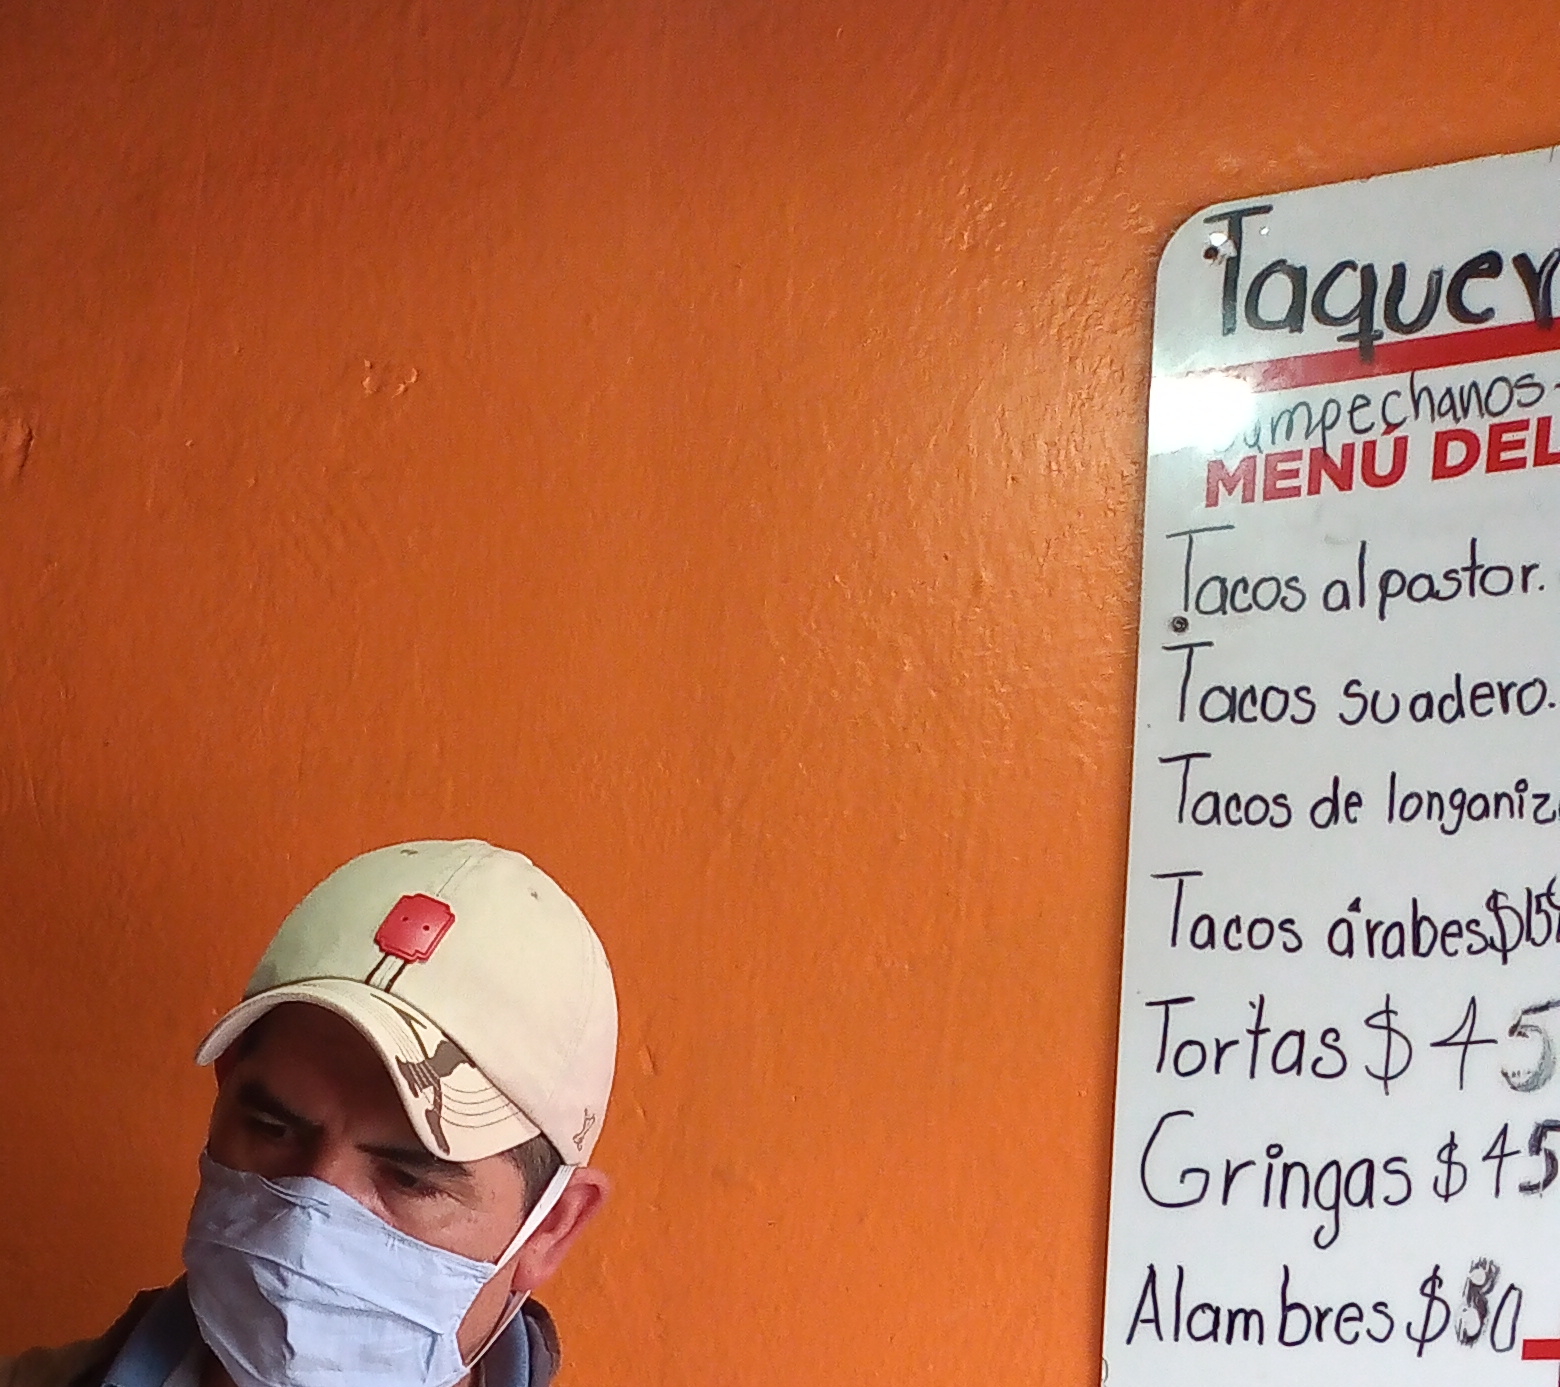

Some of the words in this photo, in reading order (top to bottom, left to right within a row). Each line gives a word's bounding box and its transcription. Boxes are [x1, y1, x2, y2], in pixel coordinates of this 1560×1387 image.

[1204, 204, 1560, 365] Taquer
[1205, 426, 1409, 508] MENÚ
[1432, 417, 1560, 482] DEL
[1166, 524, 1306, 615] Tacos
[1323, 540, 1367, 611] al
[1161, 641, 1316, 724] Tacos
[1157, 752, 1292, 829] Tacos
[1309, 775, 1362, 829] de
[1387, 771, 1560, 836] longaniz
[1150, 870, 1303, 953] Tacos
[1145, 994, 1348, 1080] Tortas
[1140, 1110, 1413, 1249] Gringas
[1126, 1264, 1395, 1347] Alambres
